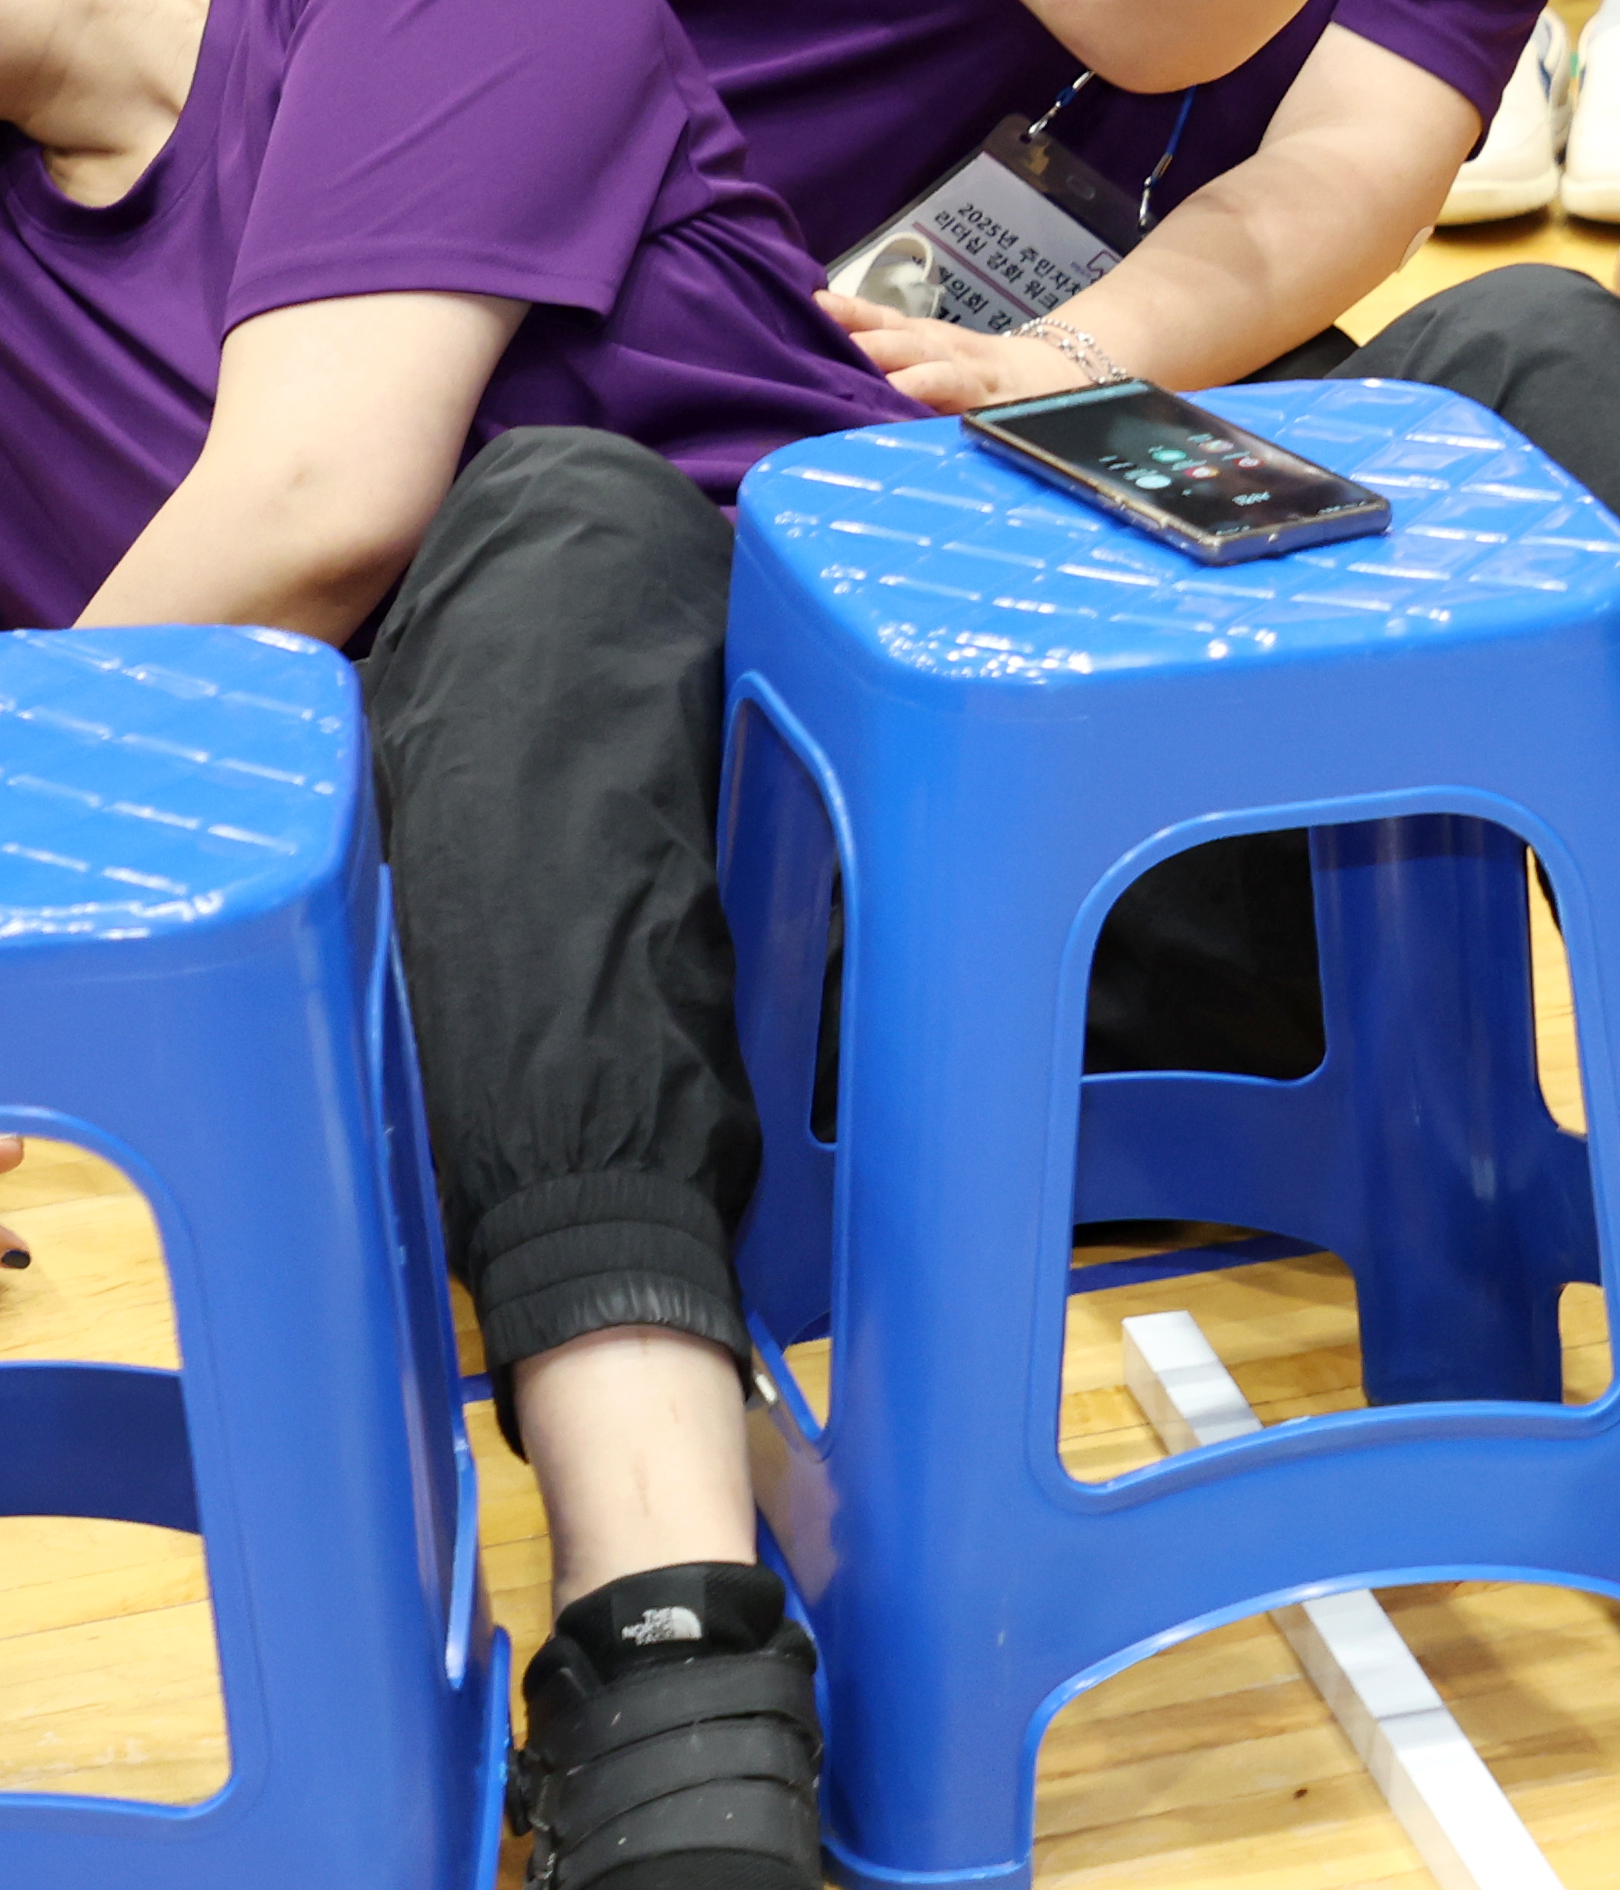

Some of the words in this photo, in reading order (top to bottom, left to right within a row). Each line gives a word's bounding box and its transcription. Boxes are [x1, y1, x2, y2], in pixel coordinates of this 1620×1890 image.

[934, 210, 988, 256] 리더십
[985, 251, 1025, 284] 강화
[957, 202, 1019, 251] 2025년
